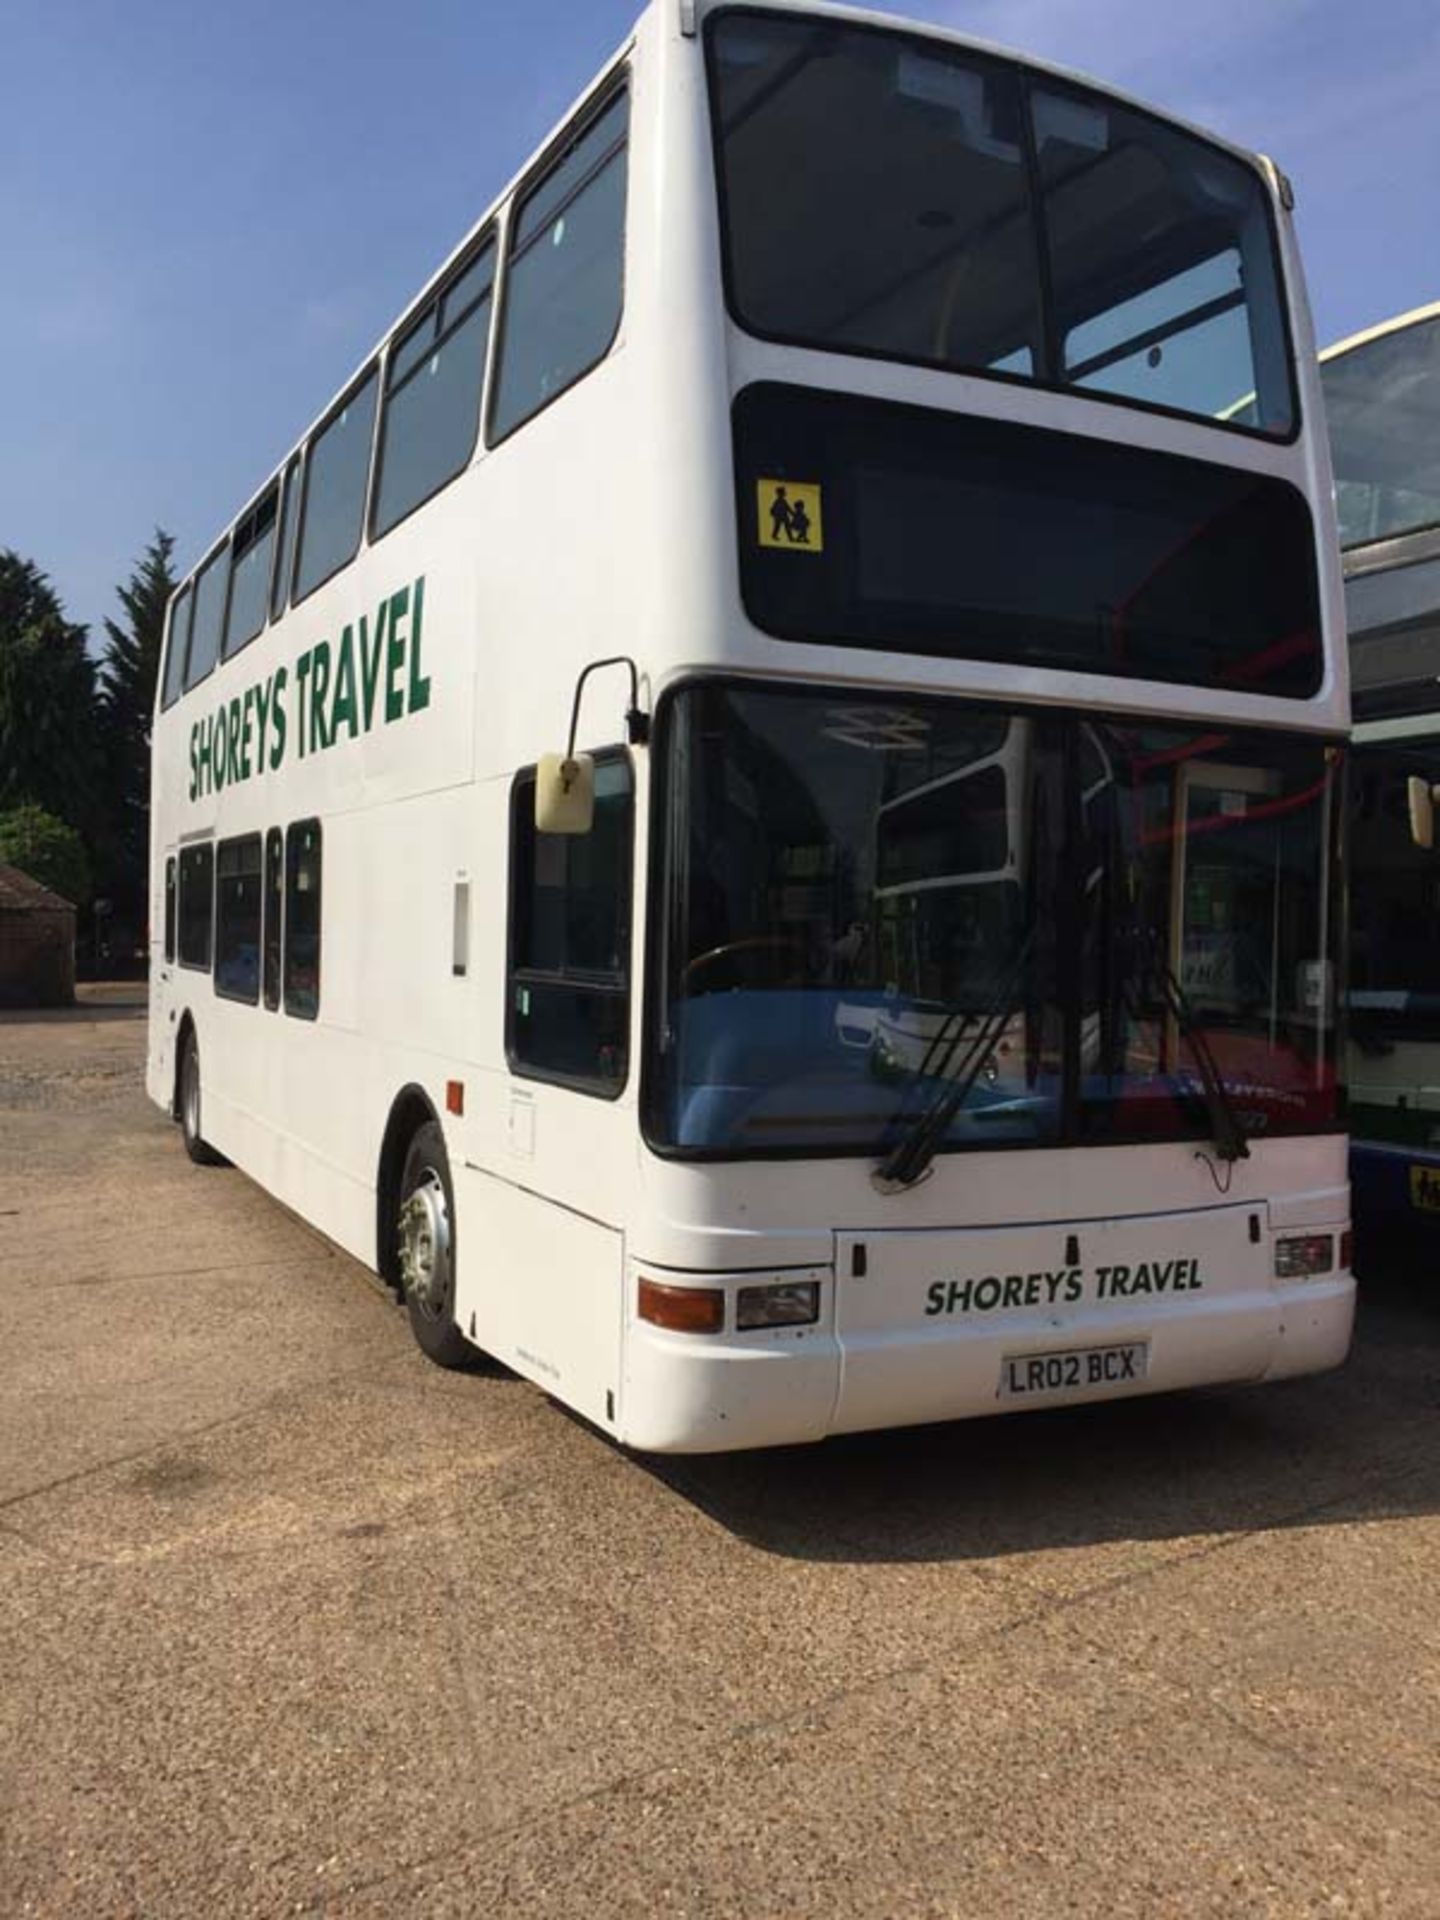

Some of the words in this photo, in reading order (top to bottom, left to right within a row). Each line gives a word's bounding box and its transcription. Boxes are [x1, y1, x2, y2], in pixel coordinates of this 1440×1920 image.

[189, 666, 288, 802] SHOREYS
[296, 575, 431, 759] TRAVEL
[925, 1269, 1083, 1315] SHOREYS
[1095, 1259, 1203, 1298] TRAVEL
[1010, 1356, 1080, 1393] LR02
[1088, 1349, 1137, 1384] BCX
